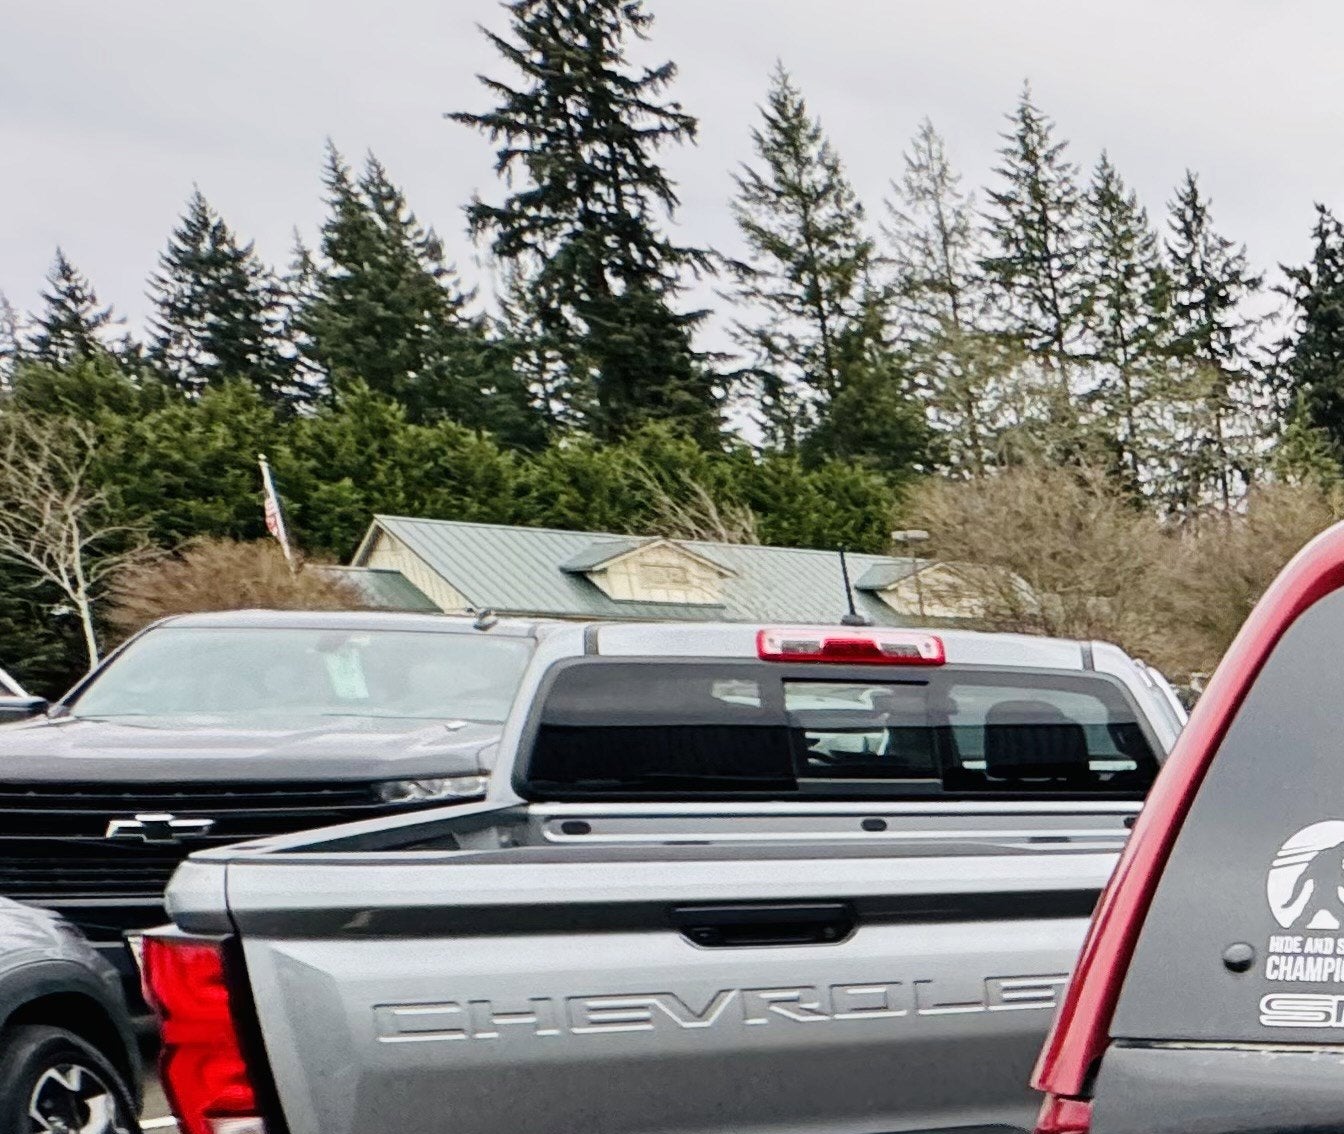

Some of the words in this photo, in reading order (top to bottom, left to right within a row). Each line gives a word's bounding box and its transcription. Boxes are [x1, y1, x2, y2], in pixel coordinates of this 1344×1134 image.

[1269, 935, 1303, 953] HIDE
[1303, 936, 1334, 955] AND
[373, 973, 1070, 1043] CHEVROLE
